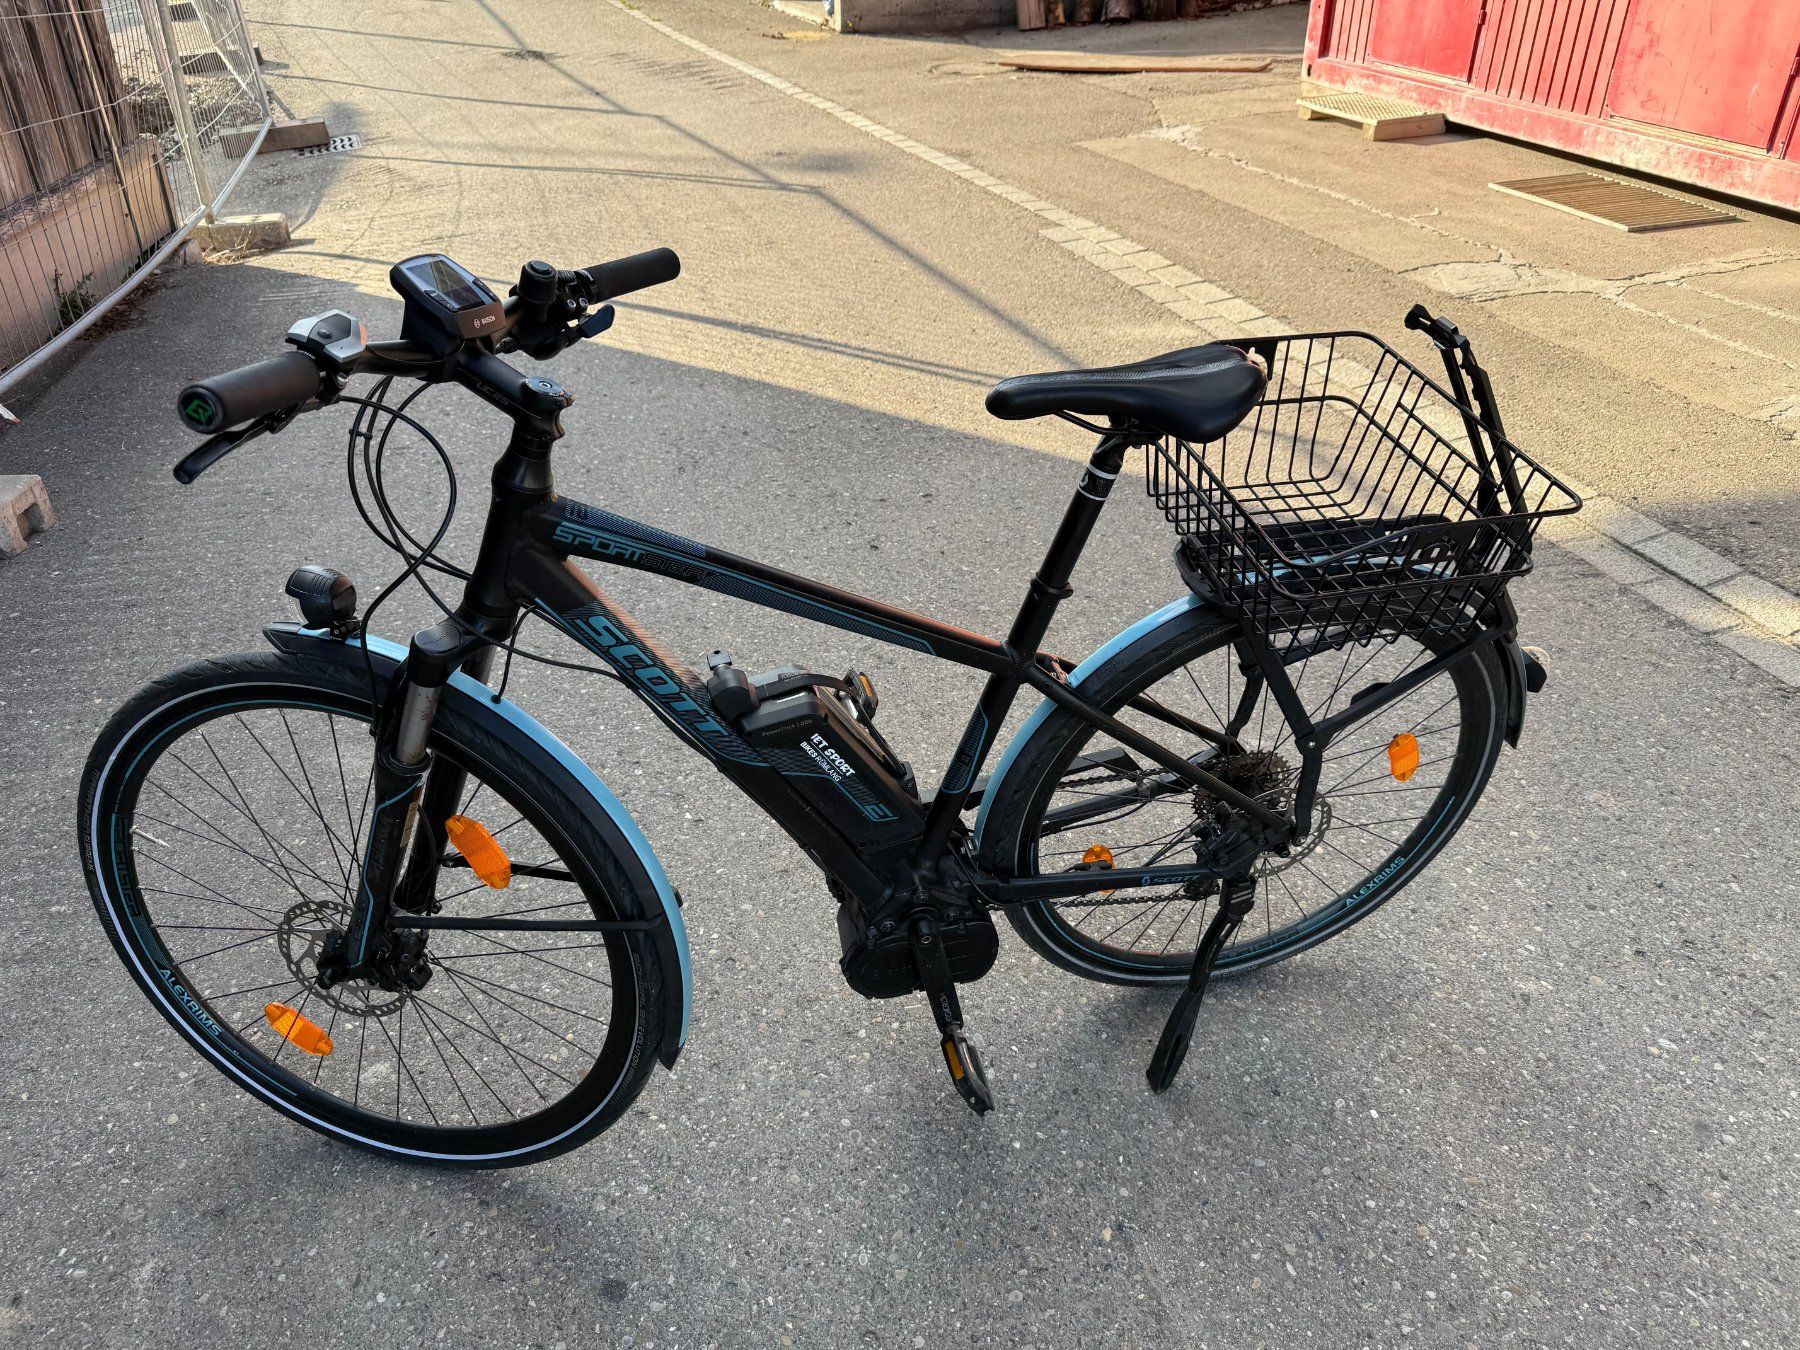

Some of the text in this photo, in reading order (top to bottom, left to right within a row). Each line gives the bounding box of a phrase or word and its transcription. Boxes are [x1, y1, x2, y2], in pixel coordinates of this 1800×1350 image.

[481, 315, 496, 325] BOSCH
[574, 615, 729, 737] SCOTT
[800, 741, 842, 782] BIKES RÜMLANG
[824, 748, 855, 777] SPORT
[1151, 874, 1201, 885] SCOTT
[1346, 855, 1406, 907] ALEXRIMS
[160, 970, 222, 1035] ALEXRIMS
[632, 1027, 645, 1066] EVOLUTION
